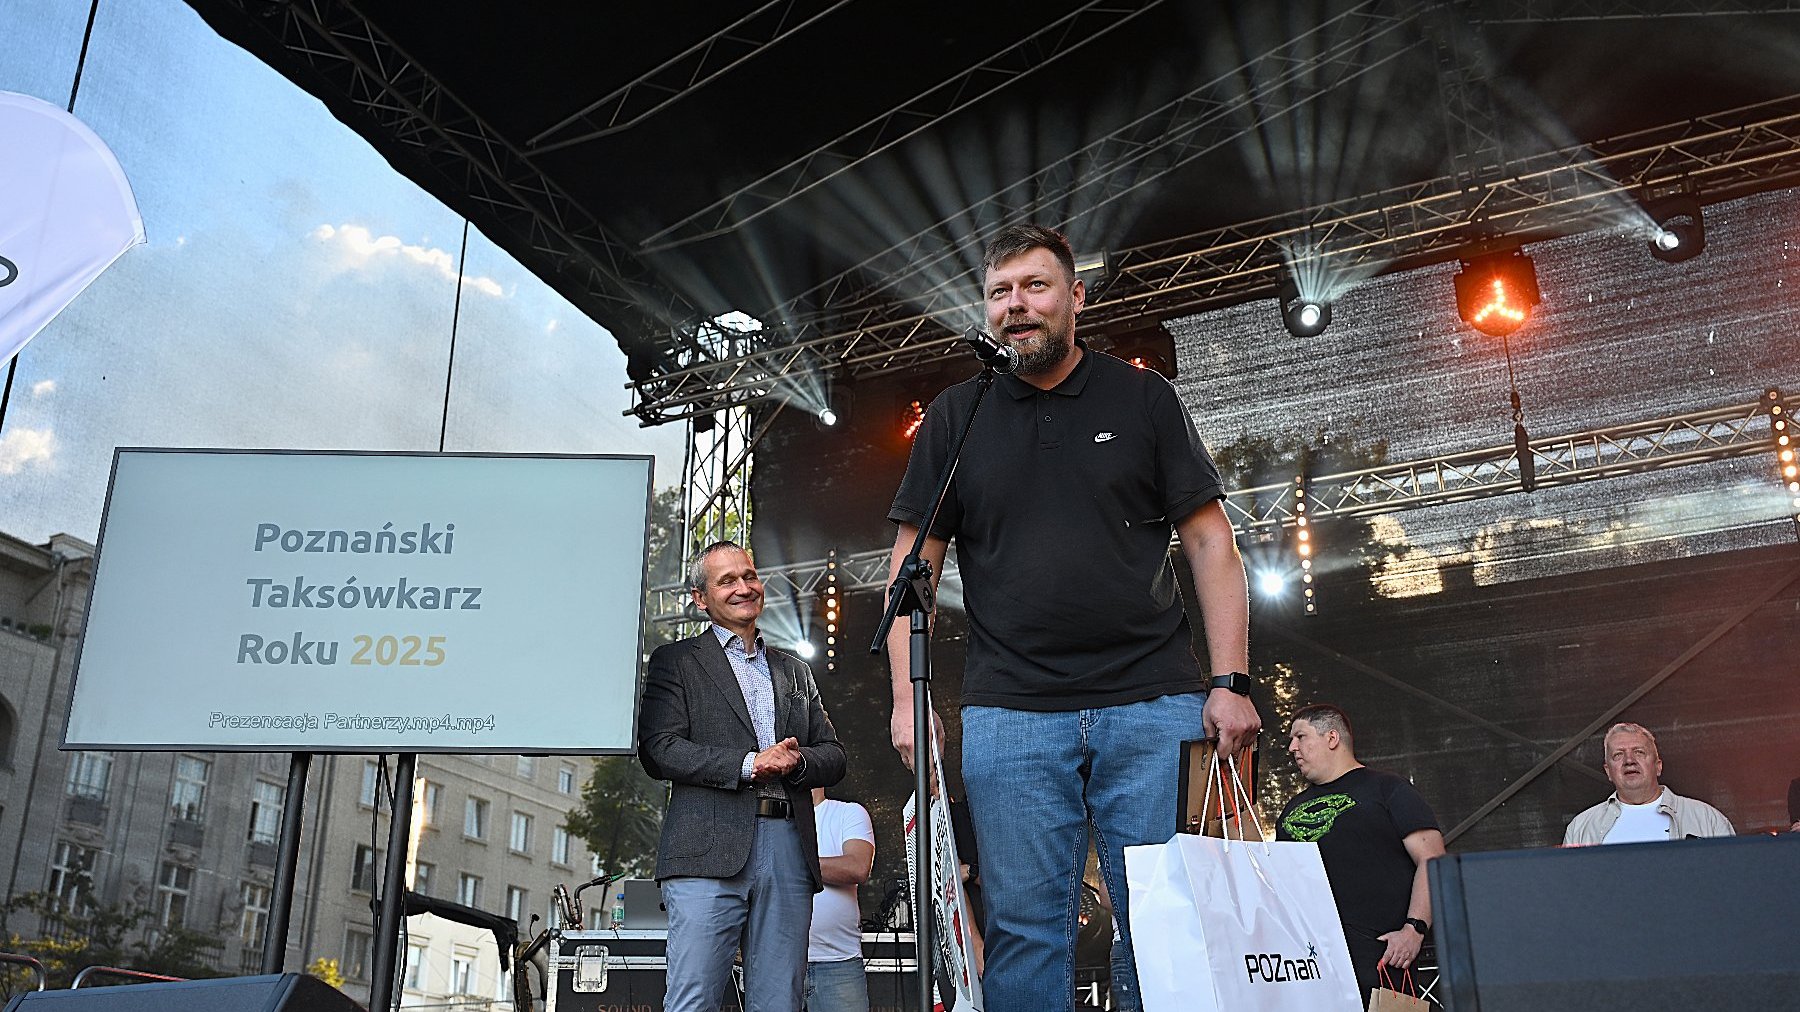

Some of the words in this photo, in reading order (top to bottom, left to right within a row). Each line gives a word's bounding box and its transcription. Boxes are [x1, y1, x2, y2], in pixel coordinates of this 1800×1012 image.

[254, 521, 455, 554] Poznański
[246, 575, 482, 610] Taksówkarz
[237, 631, 339, 666] Roku
[350, 634, 447, 667] 2025
[208, 711, 319, 733] Prezencacja
[323, 712, 495, 734] Partnerzy.mp4.mp4
